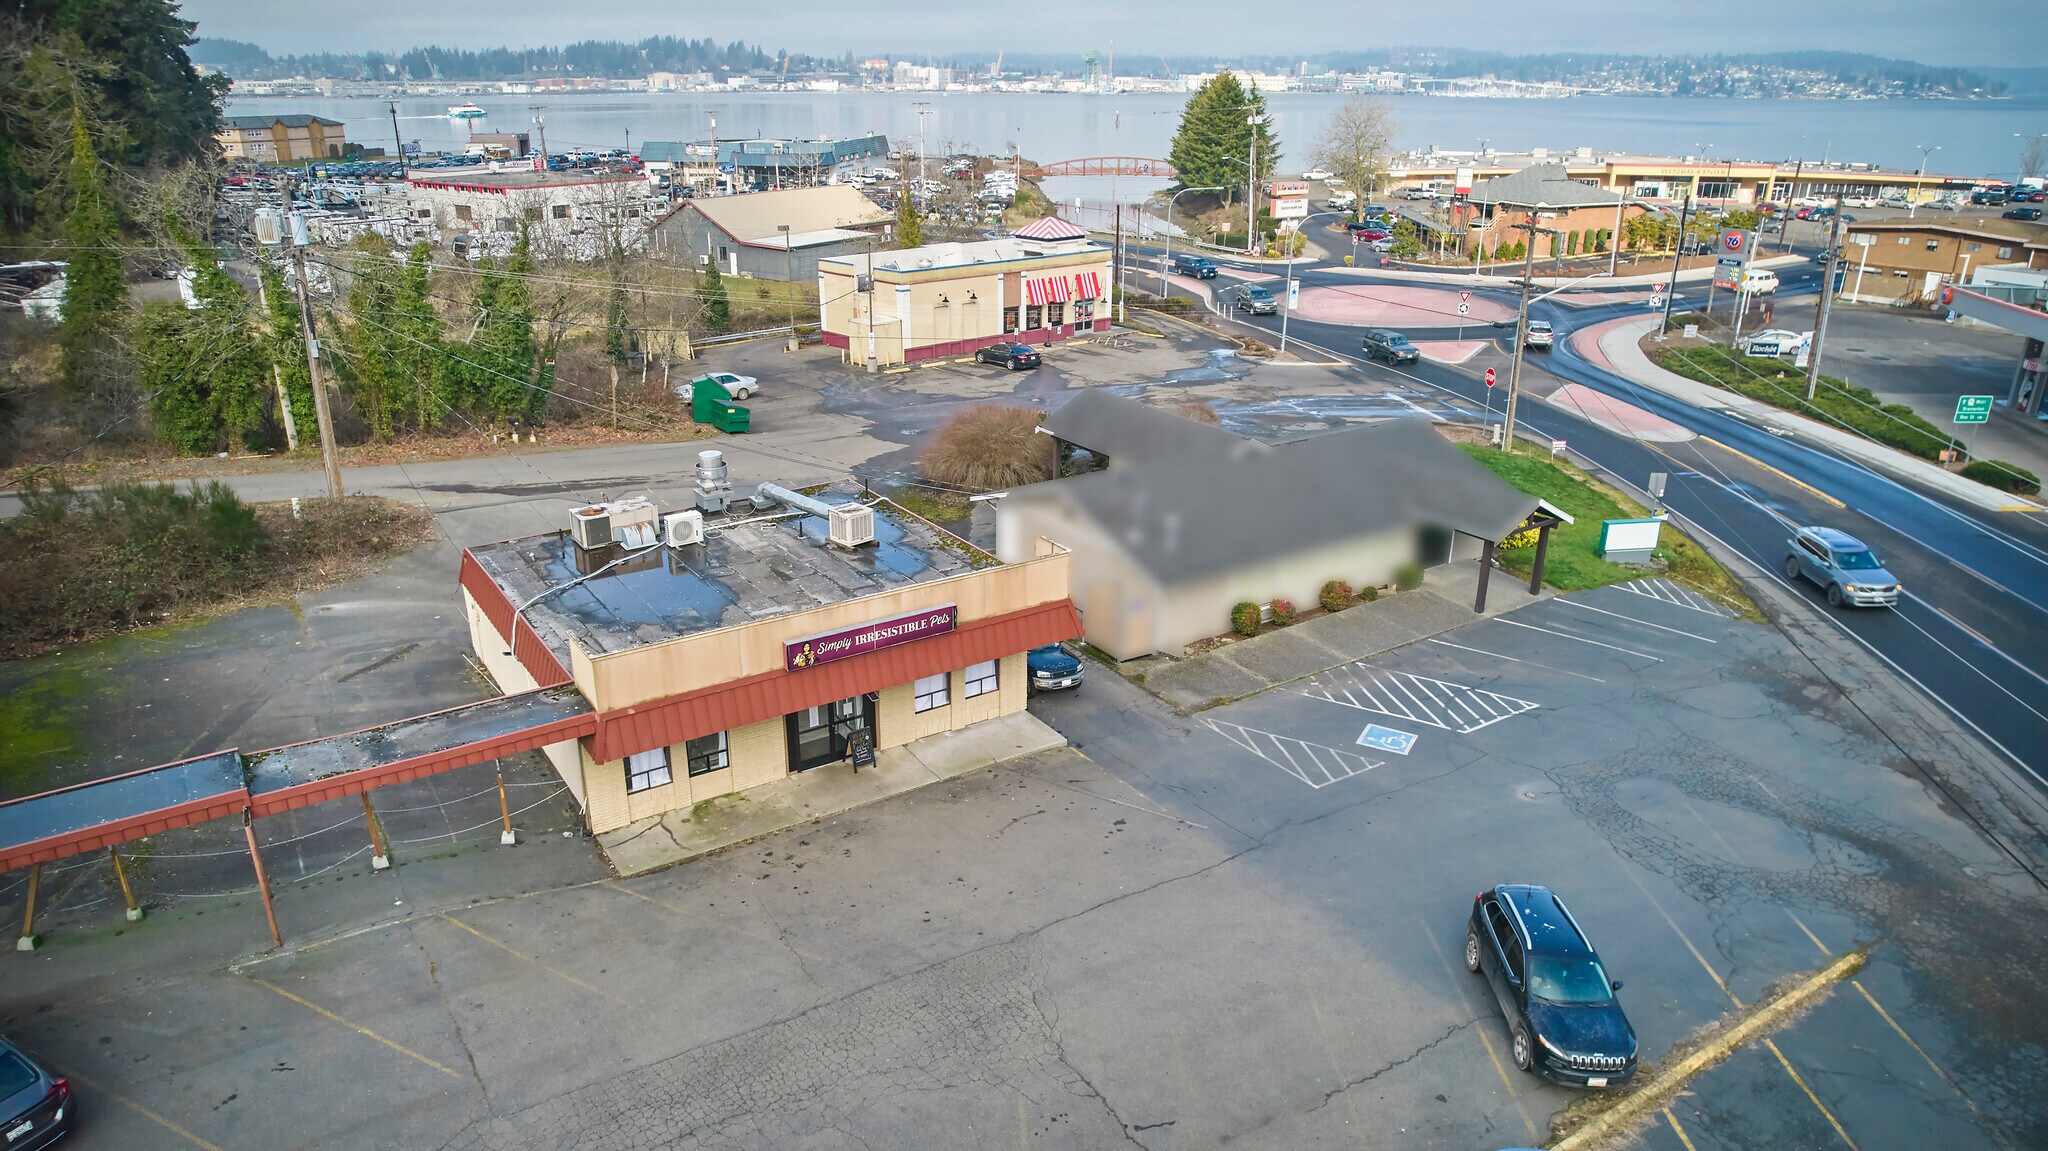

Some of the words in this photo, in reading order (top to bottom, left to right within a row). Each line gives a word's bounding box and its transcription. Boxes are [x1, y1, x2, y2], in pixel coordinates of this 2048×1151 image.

[1726, 235, 1740, 247] 76
[1751, 344, 1778, 354] Rocket
[1486, 372, 1496, 382] STOP
[816, 636, 853, 655] Simply
[855, 619, 928, 646] IRRESISTIBLE
[930, 613, 950, 628] Pets
